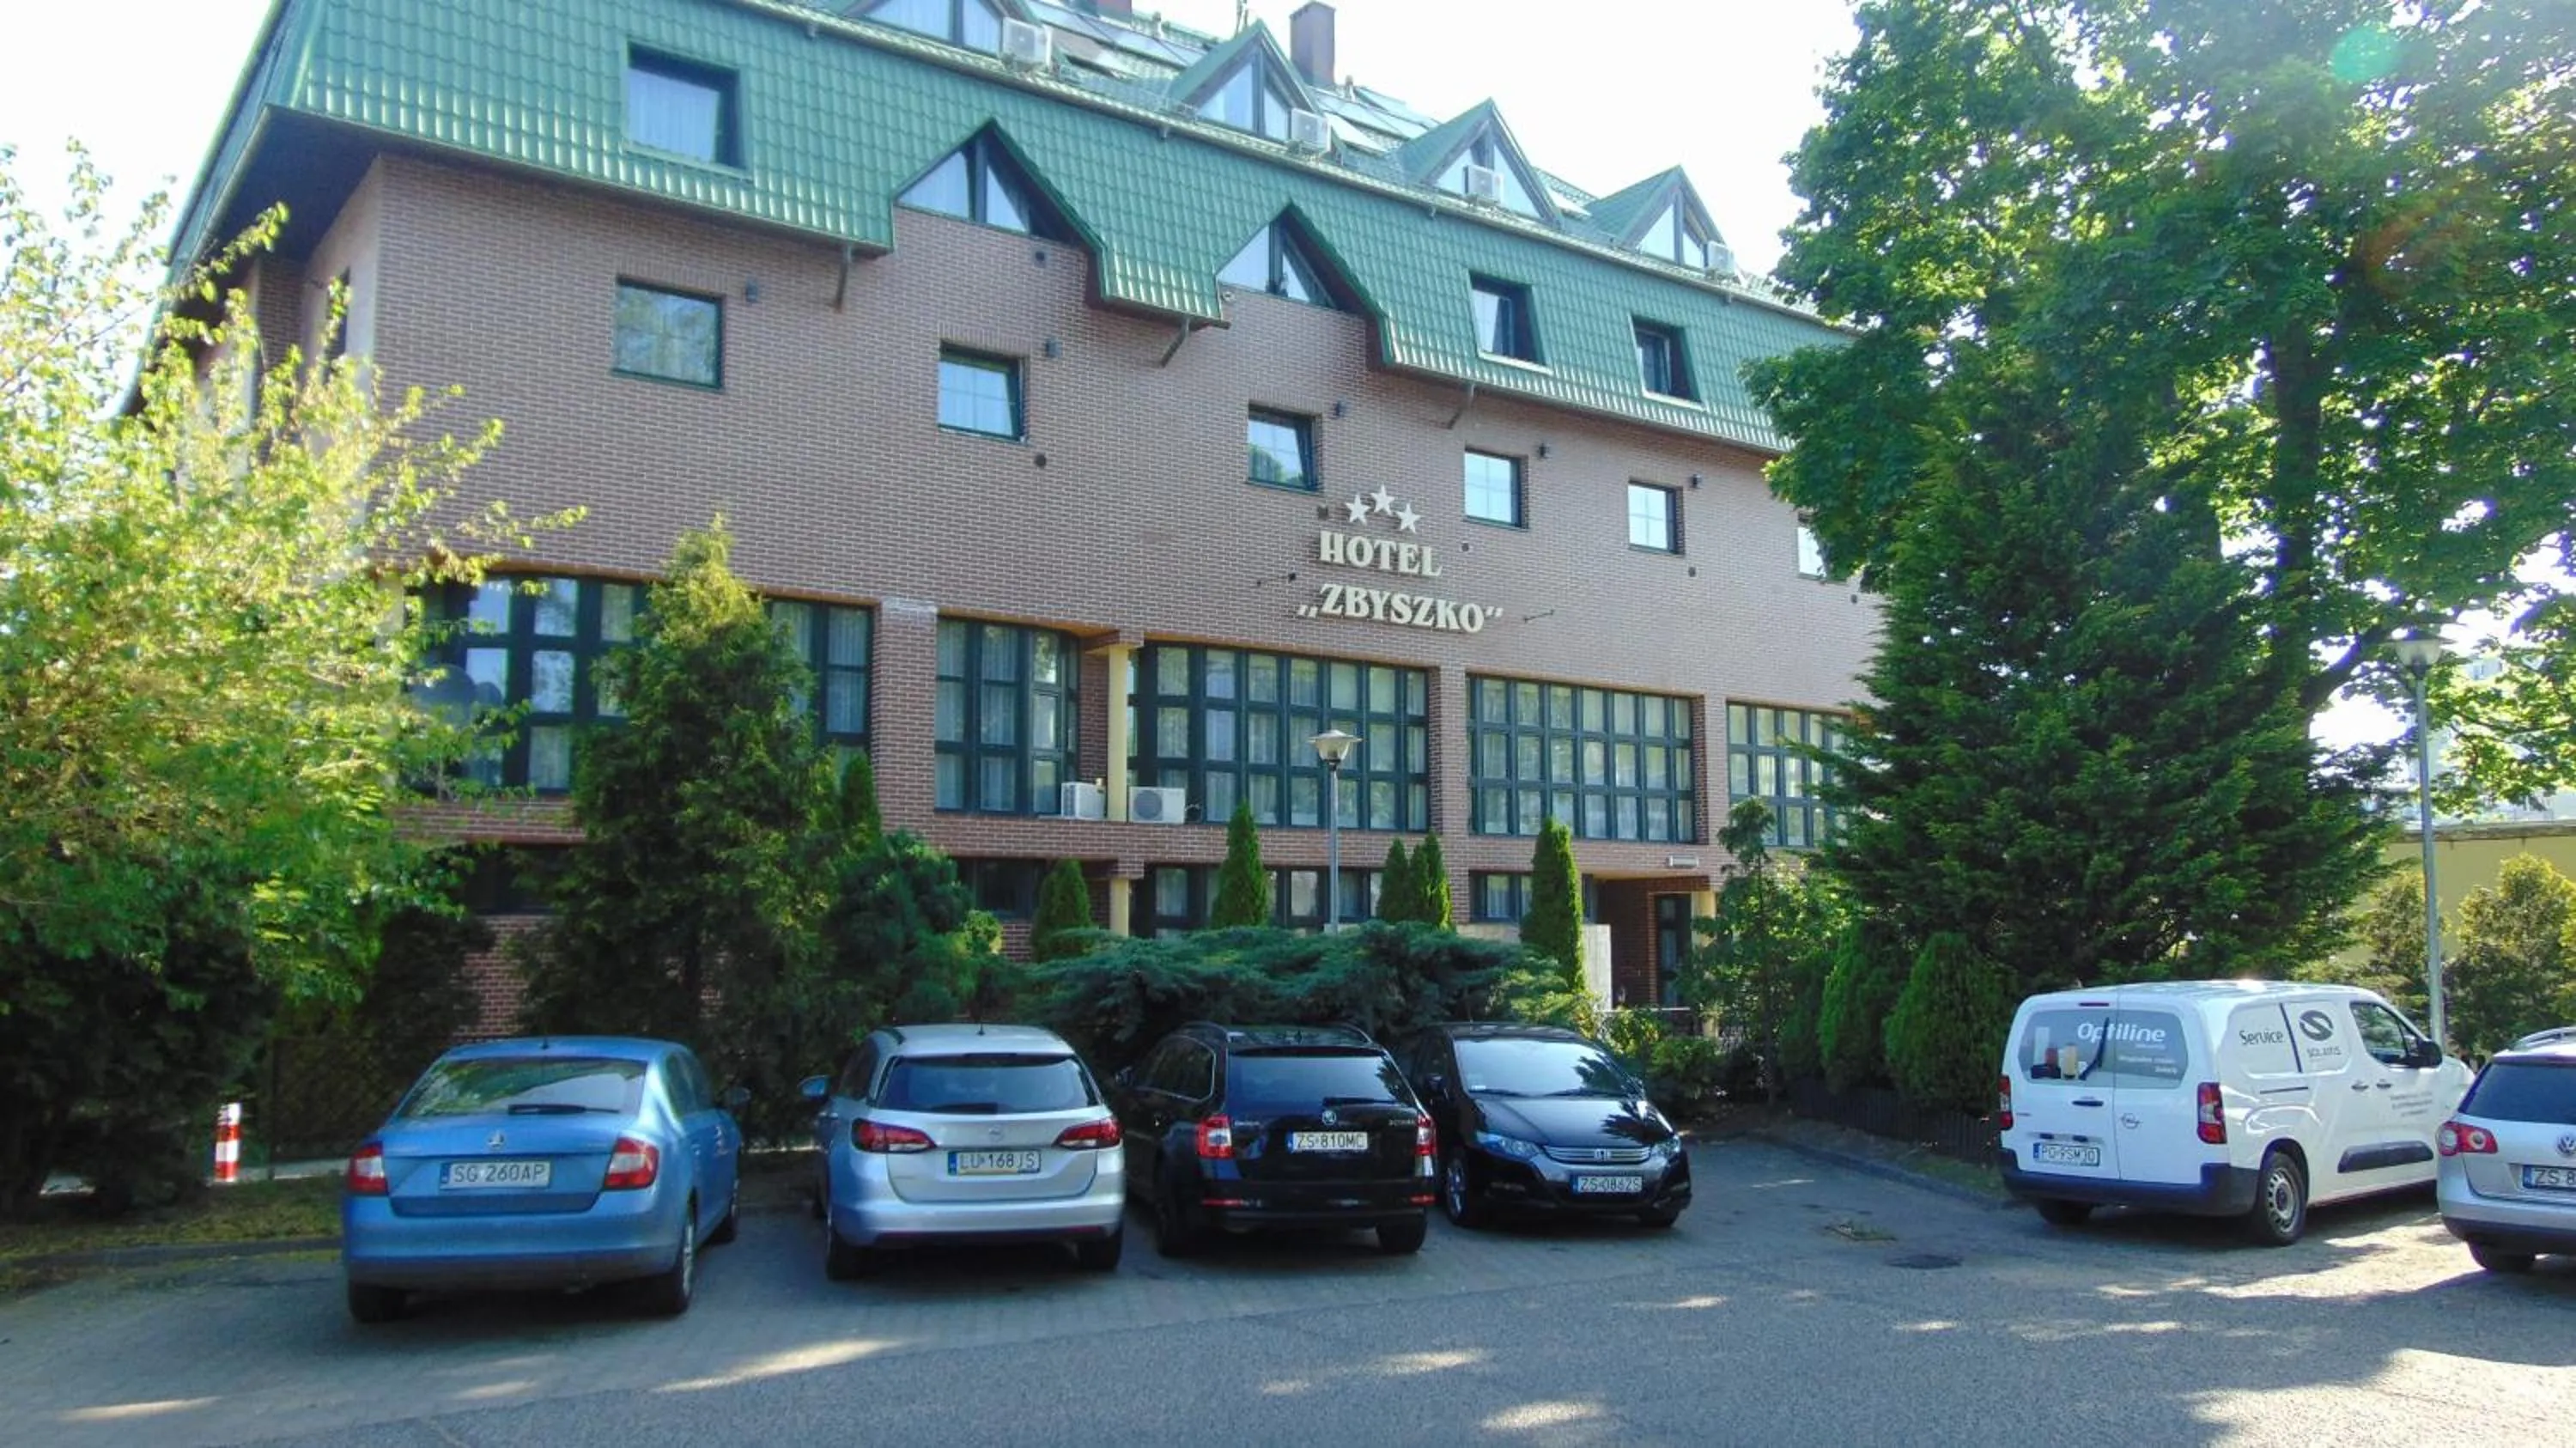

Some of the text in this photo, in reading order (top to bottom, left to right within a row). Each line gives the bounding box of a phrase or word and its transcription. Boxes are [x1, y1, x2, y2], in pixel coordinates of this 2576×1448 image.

[1319, 530, 1443, 577] HOTEL
[2077, 1023, 2166, 1043] Optiline
[2239, 1029, 2284, 1045] Service
[1297, 1134, 1315, 1149] ZS
[960, 1153, 1036, 1169] LU 168JS
[454, 1164, 544, 1183] SG 260AP
[1581, 1178, 1597, 1191] ZS
